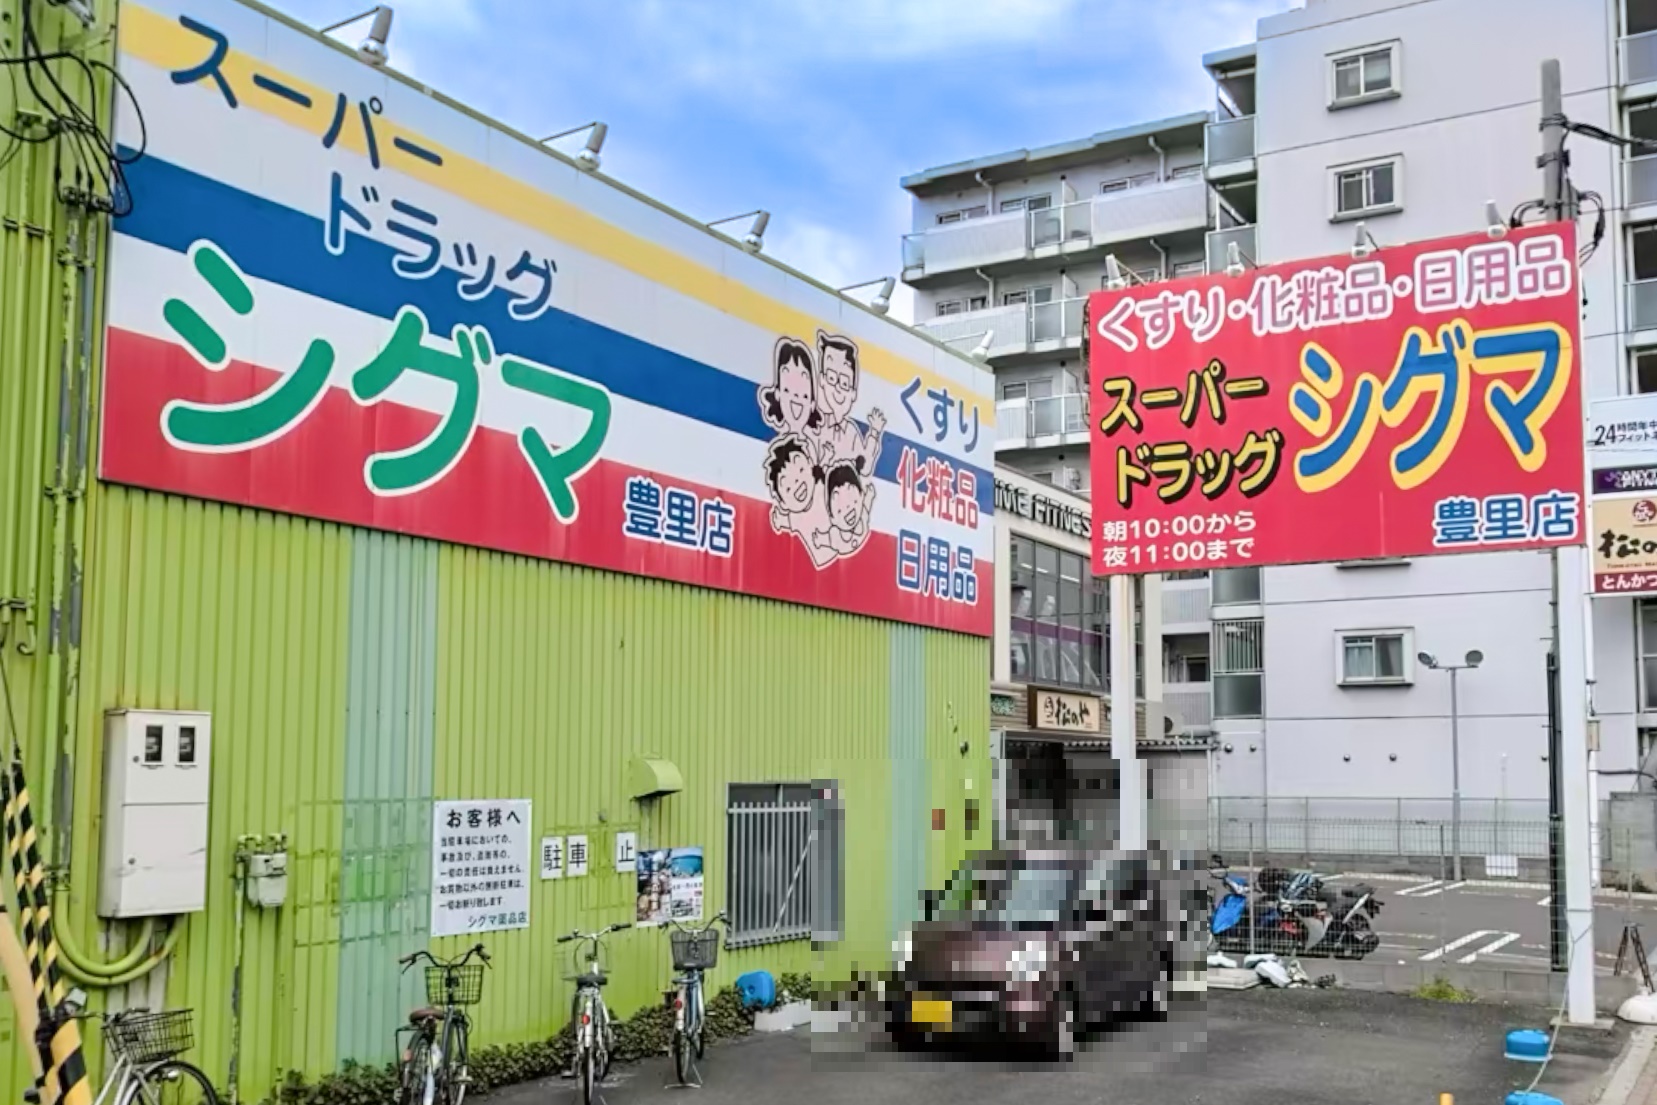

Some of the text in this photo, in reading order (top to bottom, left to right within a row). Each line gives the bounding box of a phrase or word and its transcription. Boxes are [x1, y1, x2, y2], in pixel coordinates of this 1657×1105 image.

[171, 15, 443, 169] スーパー
[325, 171, 557, 320] ドラッグ
[161, 239, 612, 523] シグマ
[900, 377, 979, 452] くすり
[1101, 358, 1269, 438] スーパー
[1287, 318, 1572, 493] シグマ
[897, 448, 979, 530] 化粧品
[1117, 429, 1285, 508] ドラッグ
[623, 475, 735, 557] 豊里店
[1103, 510, 1257, 542] 朝10:00から
[1103, 537, 1255, 568] 夜11:00まで
[1432, 491, 1580, 547] 豊里店
[897, 529, 977, 605] 日用品
[446, 808, 521, 828] お客様へ
